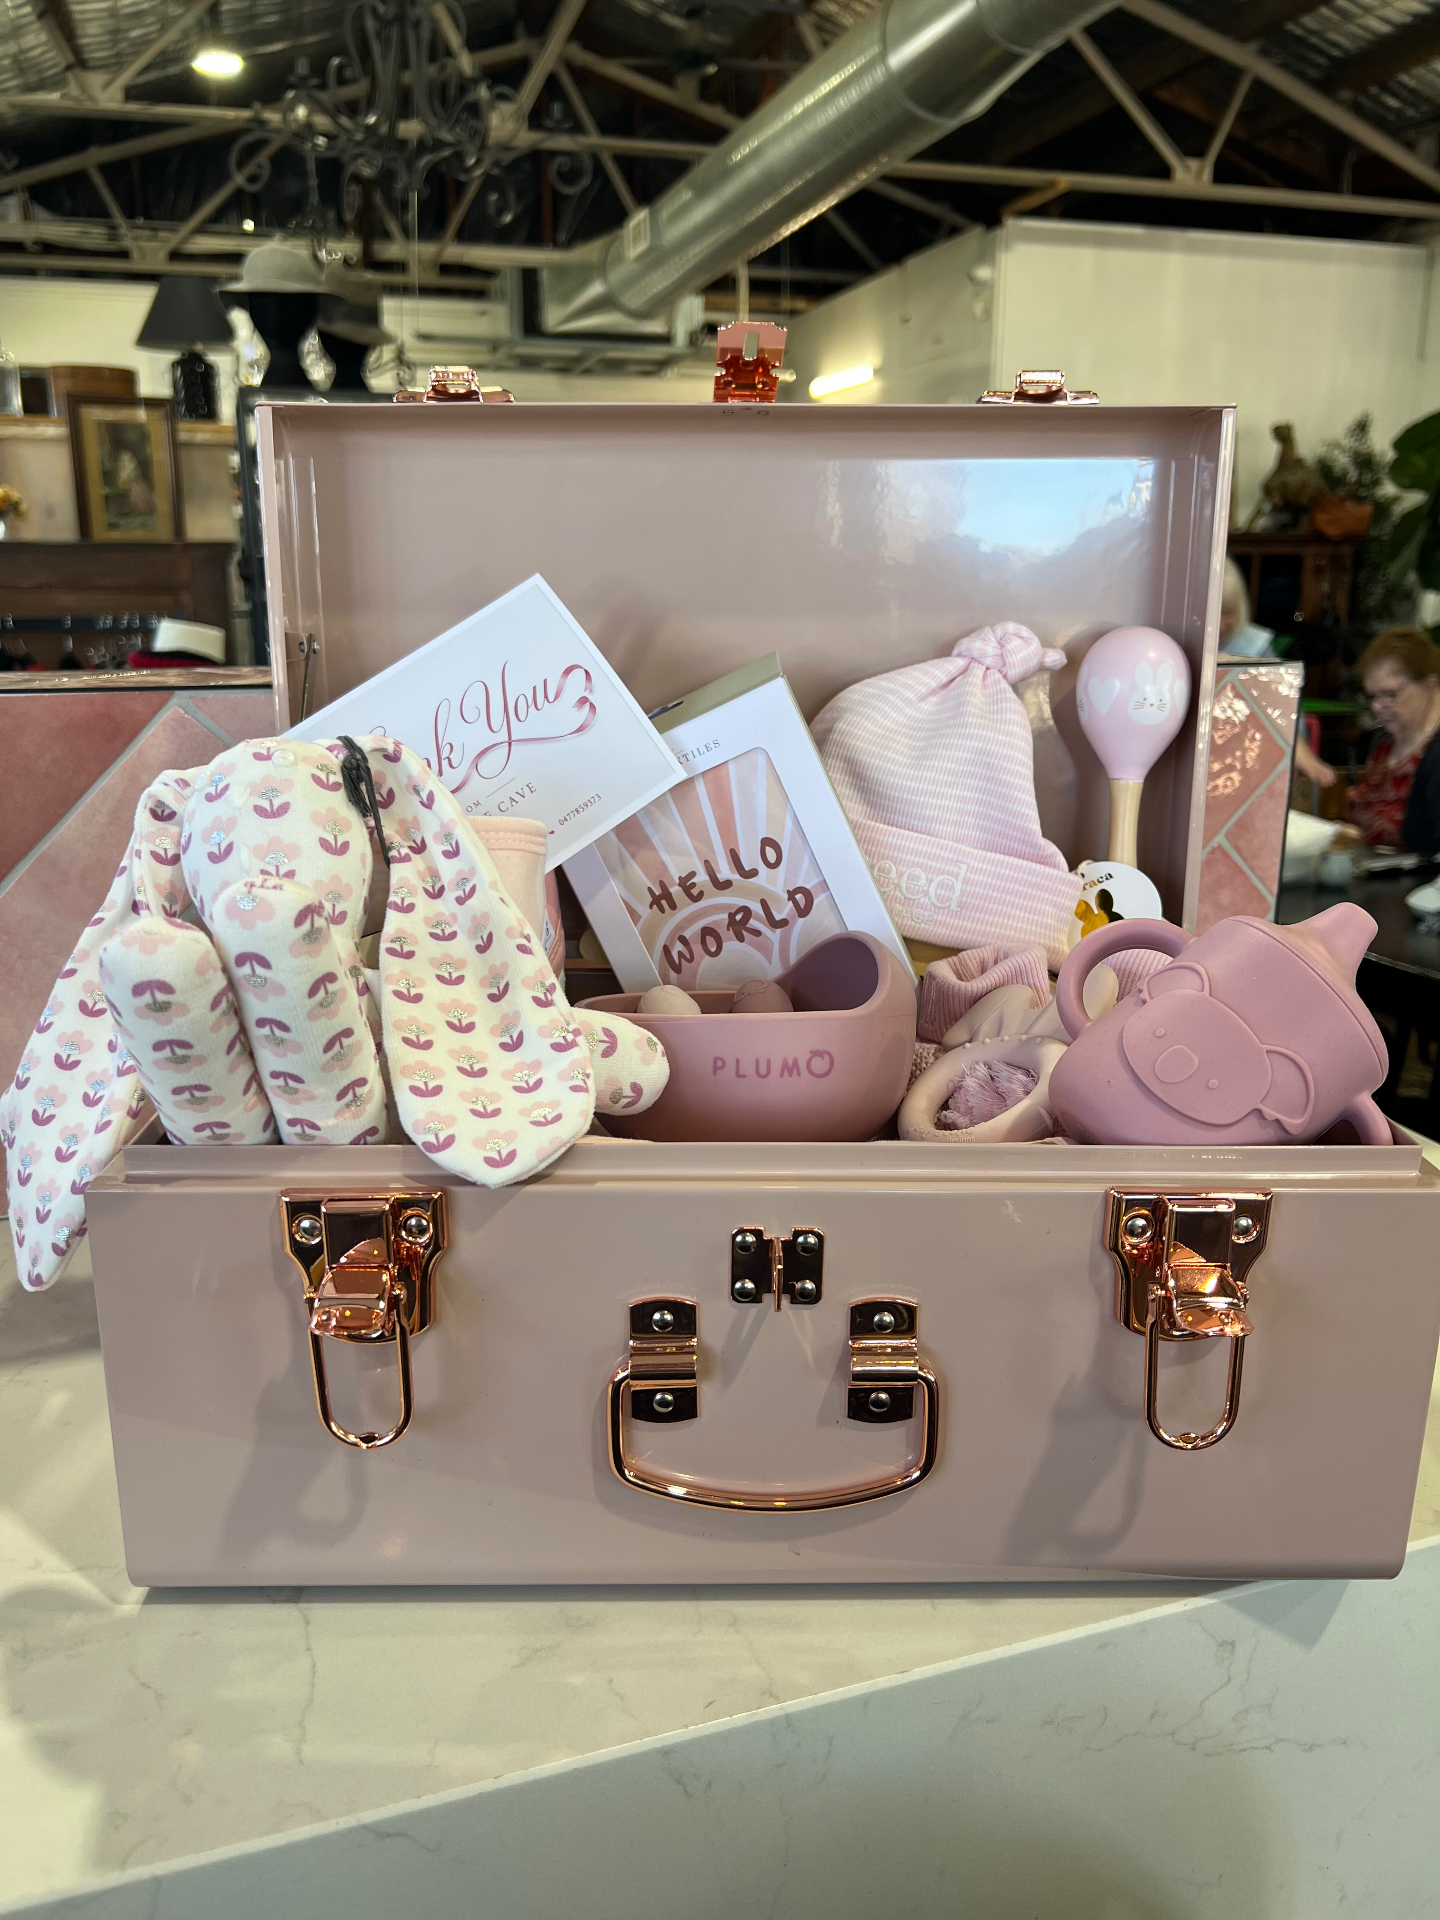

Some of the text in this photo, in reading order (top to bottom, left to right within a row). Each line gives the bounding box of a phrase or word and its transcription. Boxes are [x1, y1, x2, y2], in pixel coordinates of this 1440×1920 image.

[458, 660, 593, 780] You
[465, 799, 482, 814] OM
[497, 782, 538, 813] CAVE
[558, 793, 602, 826] 0477859373
[647, 836, 783, 914] HELLO
[662, 886, 815, 975] WORLD
[713, 1049, 835, 1079] PLUMO
